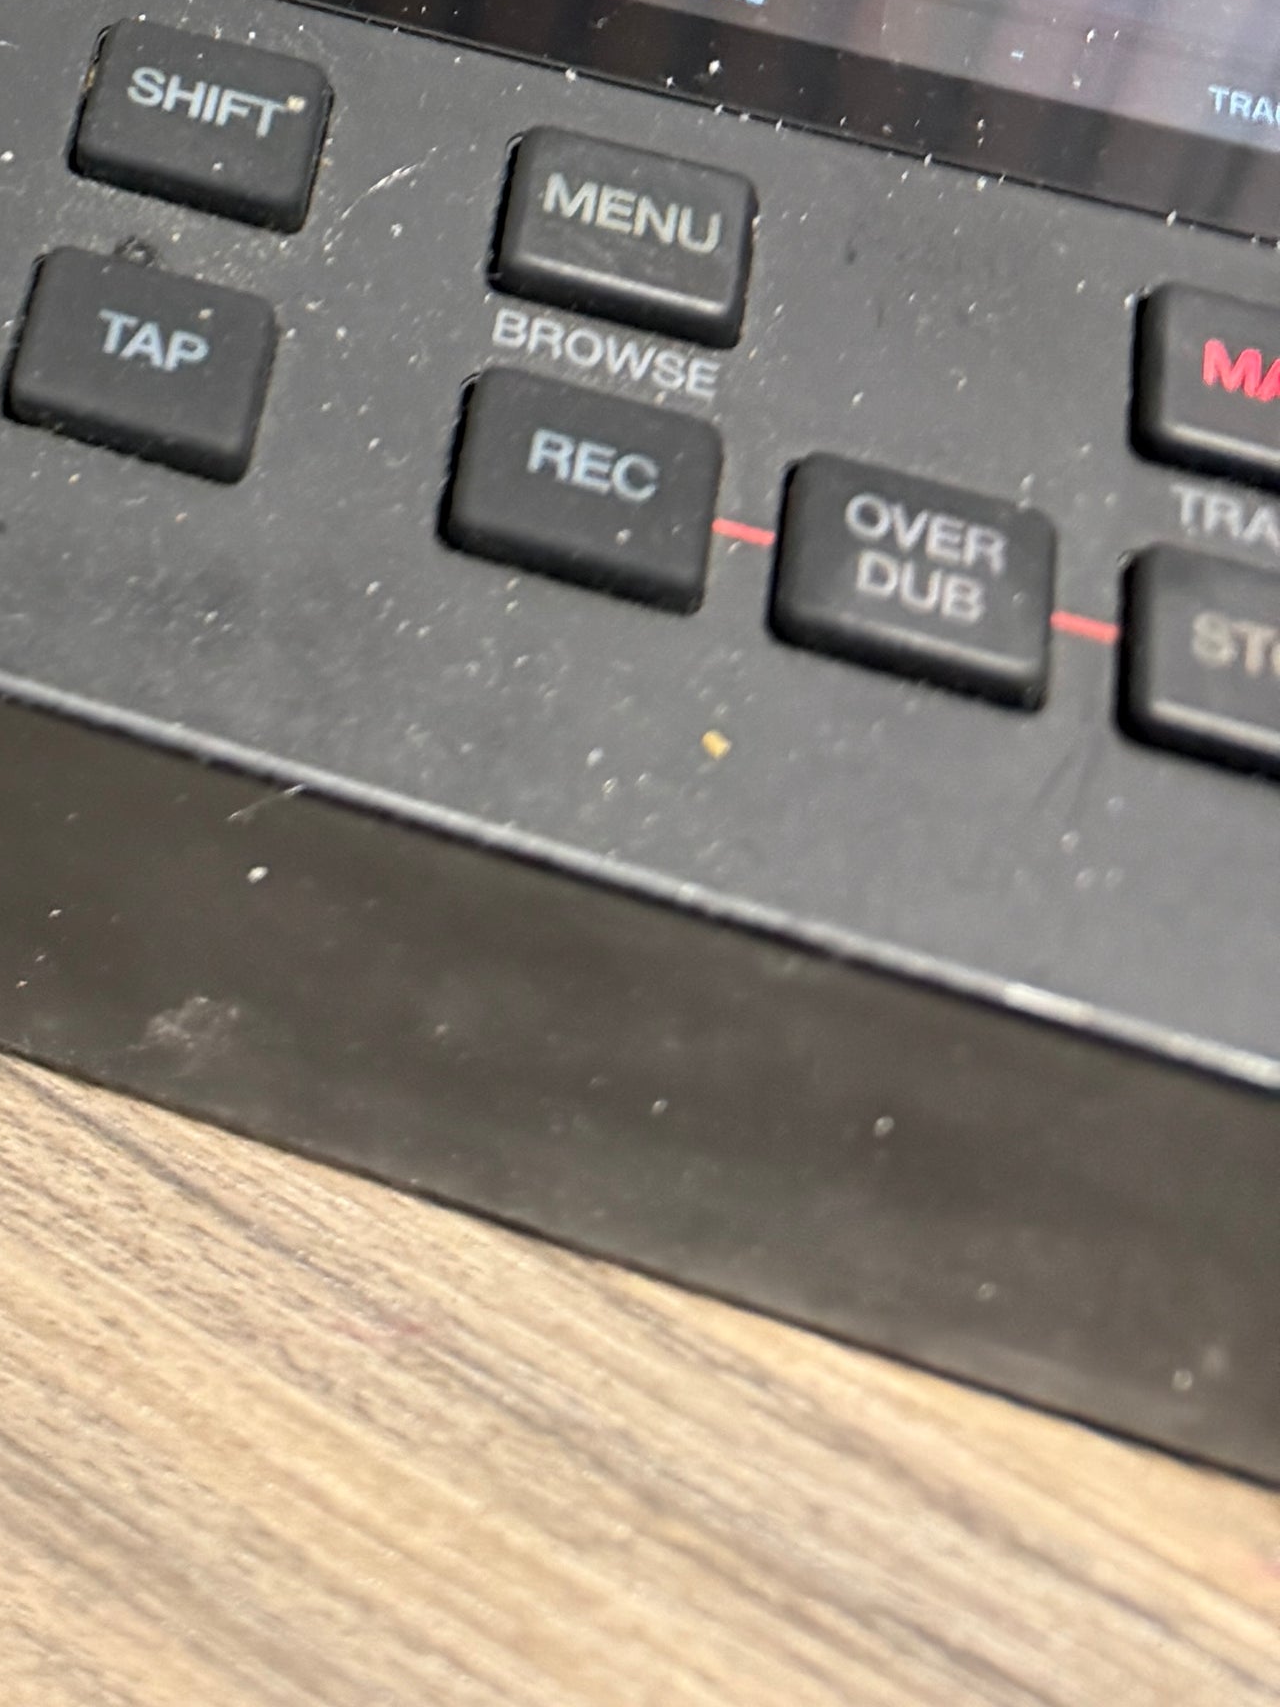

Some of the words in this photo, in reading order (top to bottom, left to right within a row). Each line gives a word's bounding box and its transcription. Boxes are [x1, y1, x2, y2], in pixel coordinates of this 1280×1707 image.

[126, 65, 288, 138] SHIFT
[1208, 84, 1280, 128] TRA
[541, 172, 723, 255] MENU
[98, 308, 209, 372] TAP
[491, 306, 722, 401] BROWSE
[525, 428, 660, 505] REC
[844, 493, 1009, 574] OVER
[854, 548, 986, 627] DUB
[1192, 610, 1280, 684] ST
